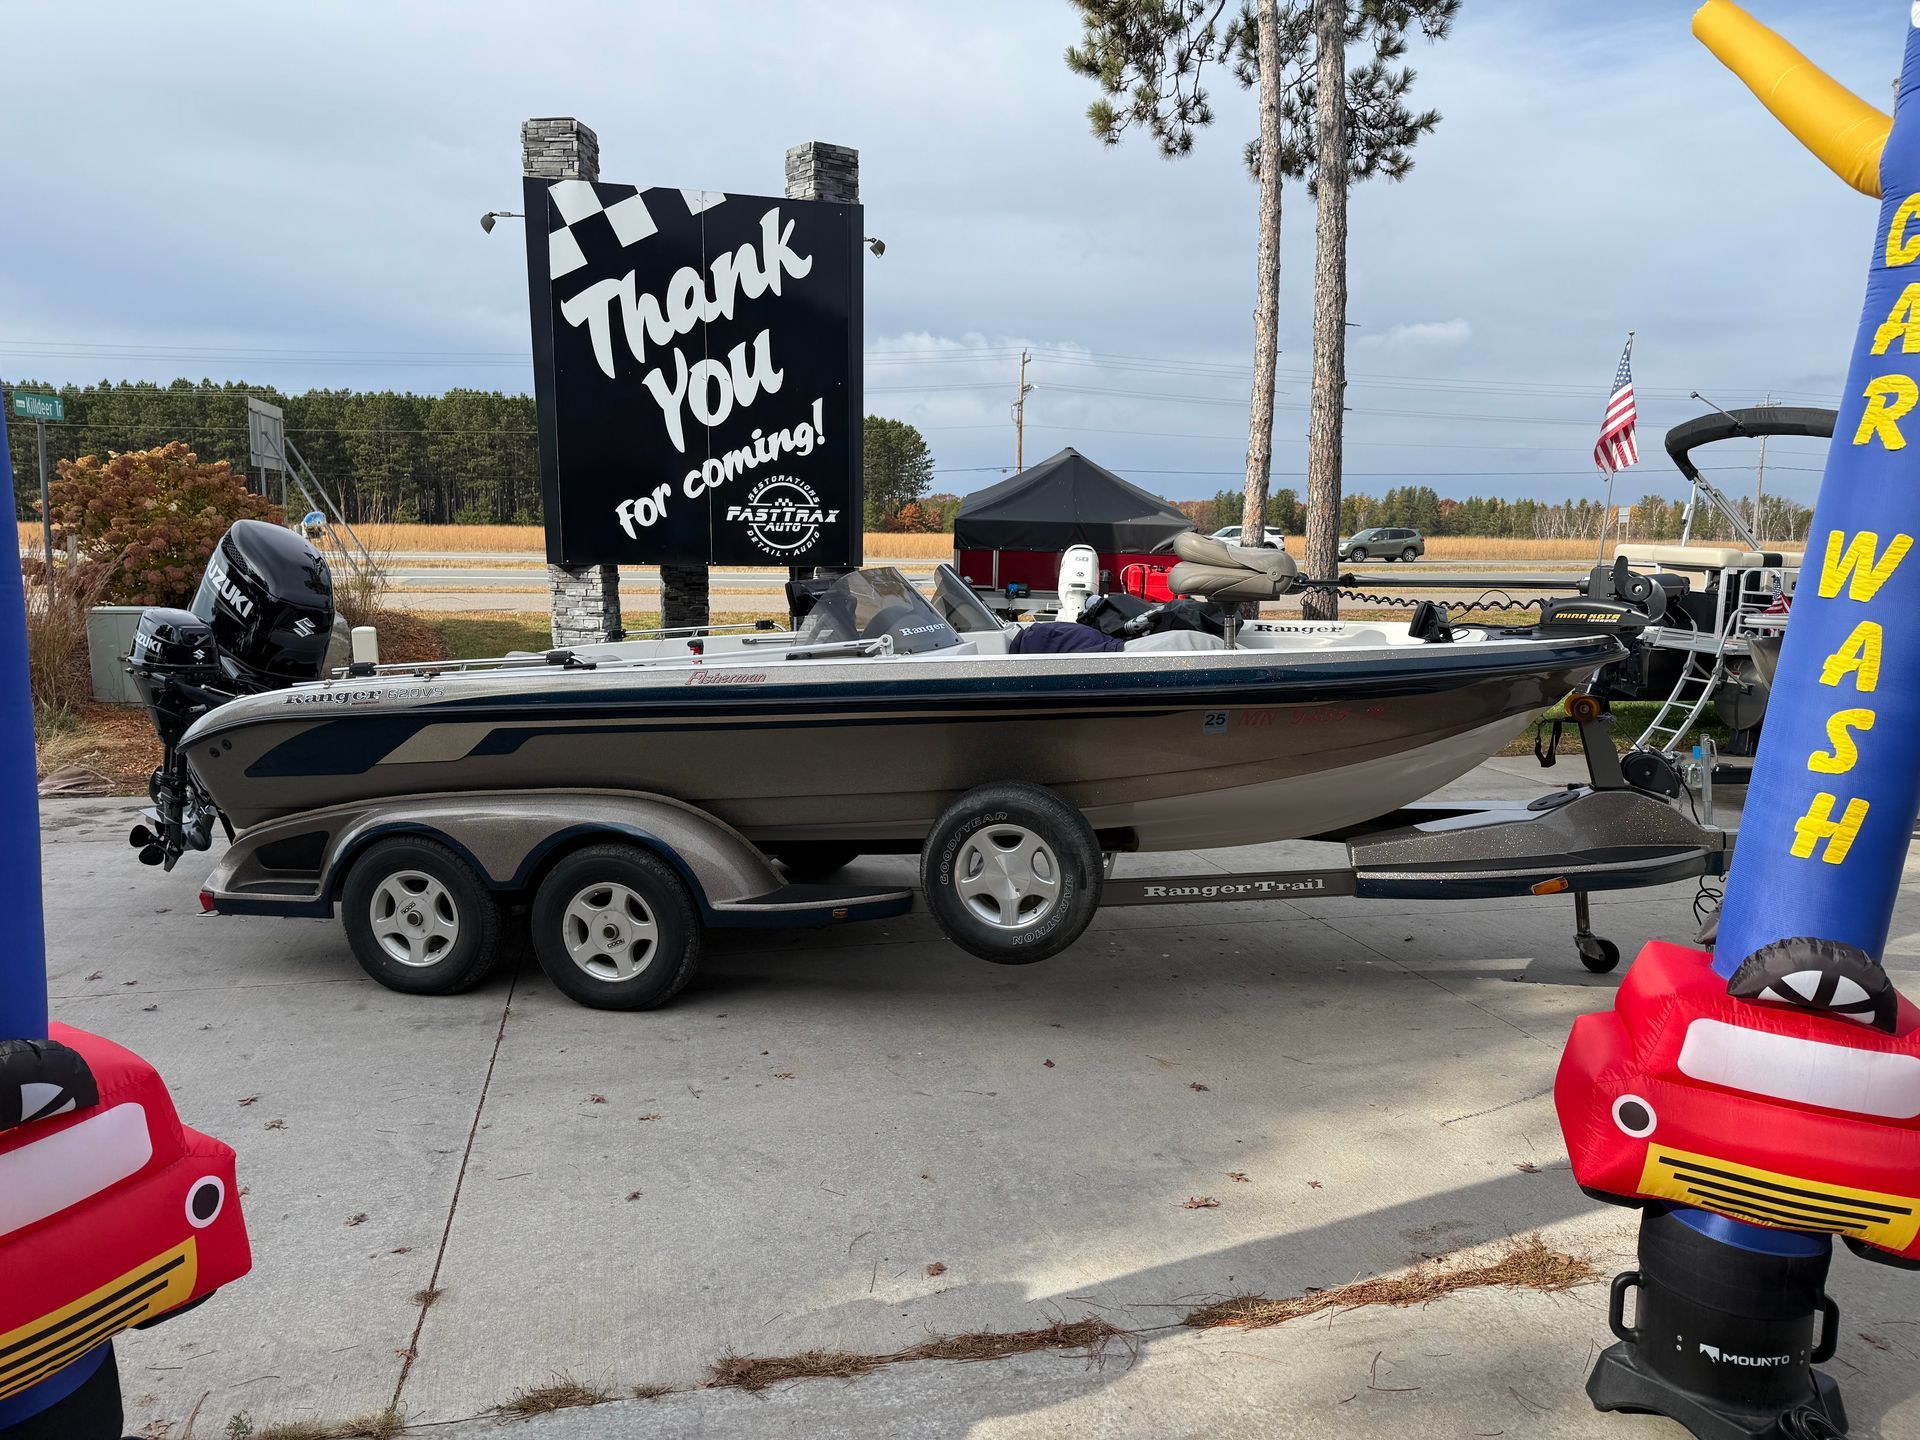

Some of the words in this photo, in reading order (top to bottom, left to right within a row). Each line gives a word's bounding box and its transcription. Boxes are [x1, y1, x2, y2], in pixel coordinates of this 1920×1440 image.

[560, 206, 813, 379] Thank
[1852, 191, 1920, 451] CAR
[641, 328, 784, 453] You
[25, 396, 53, 416] Killdeer
[54, 400, 62, 417] Tr
[615, 482, 672, 540] For
[683, 397, 826, 499] coming!
[747, 474, 821, 504] RESTORATIONS
[763, 522, 802, 532] AUTO
[746, 529, 781, 557] DETAIL
[793, 531, 821, 556] AUDIO
[208, 557, 254, 618] UZUKI
[899, 623, 946, 637] Ranger
[1254, 624, 1343, 634] Ranger
[685, 669, 767, 685] Fisherman
[283, 689, 382, 705] Ranger
[1789, 529, 1915, 865] WASH
[1204, 713, 1226, 726] 25
[940, 811, 1008, 885] GOODYEAR
[1143, 882, 1251, 898] Ranger
[1254, 878, 1325, 892] Trail
[1011, 873, 1073, 945] MARATHON
[1722, 1353, 1790, 1367] MOUNTO
